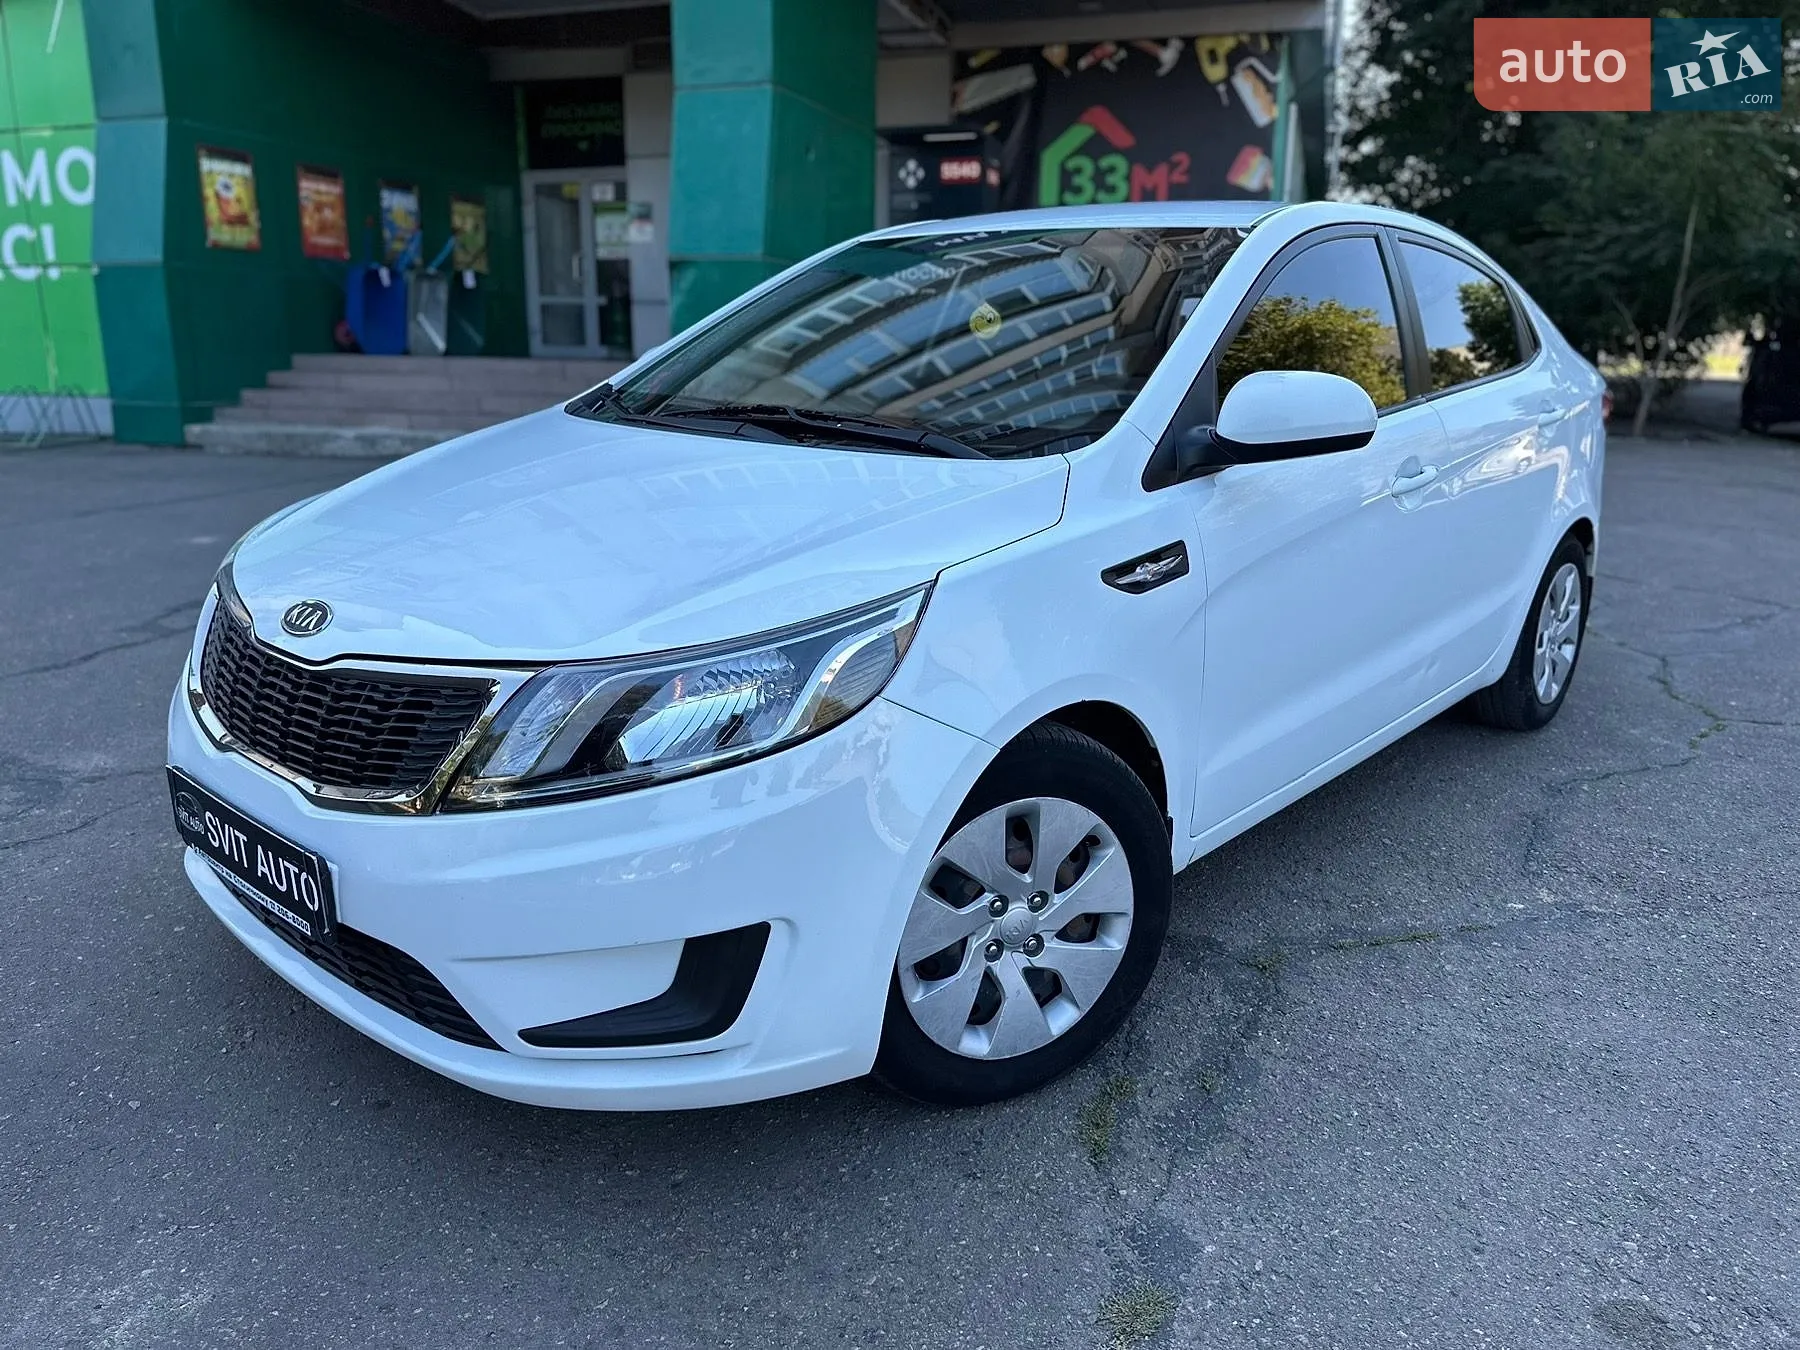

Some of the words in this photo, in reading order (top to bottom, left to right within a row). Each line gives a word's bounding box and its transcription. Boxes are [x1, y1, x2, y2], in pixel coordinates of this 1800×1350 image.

[0, 222, 61, 281] С!
[286, 604, 323, 631] KIA
[205, 810, 248, 868] SVIT
[257, 844, 319, 912] AUTO
